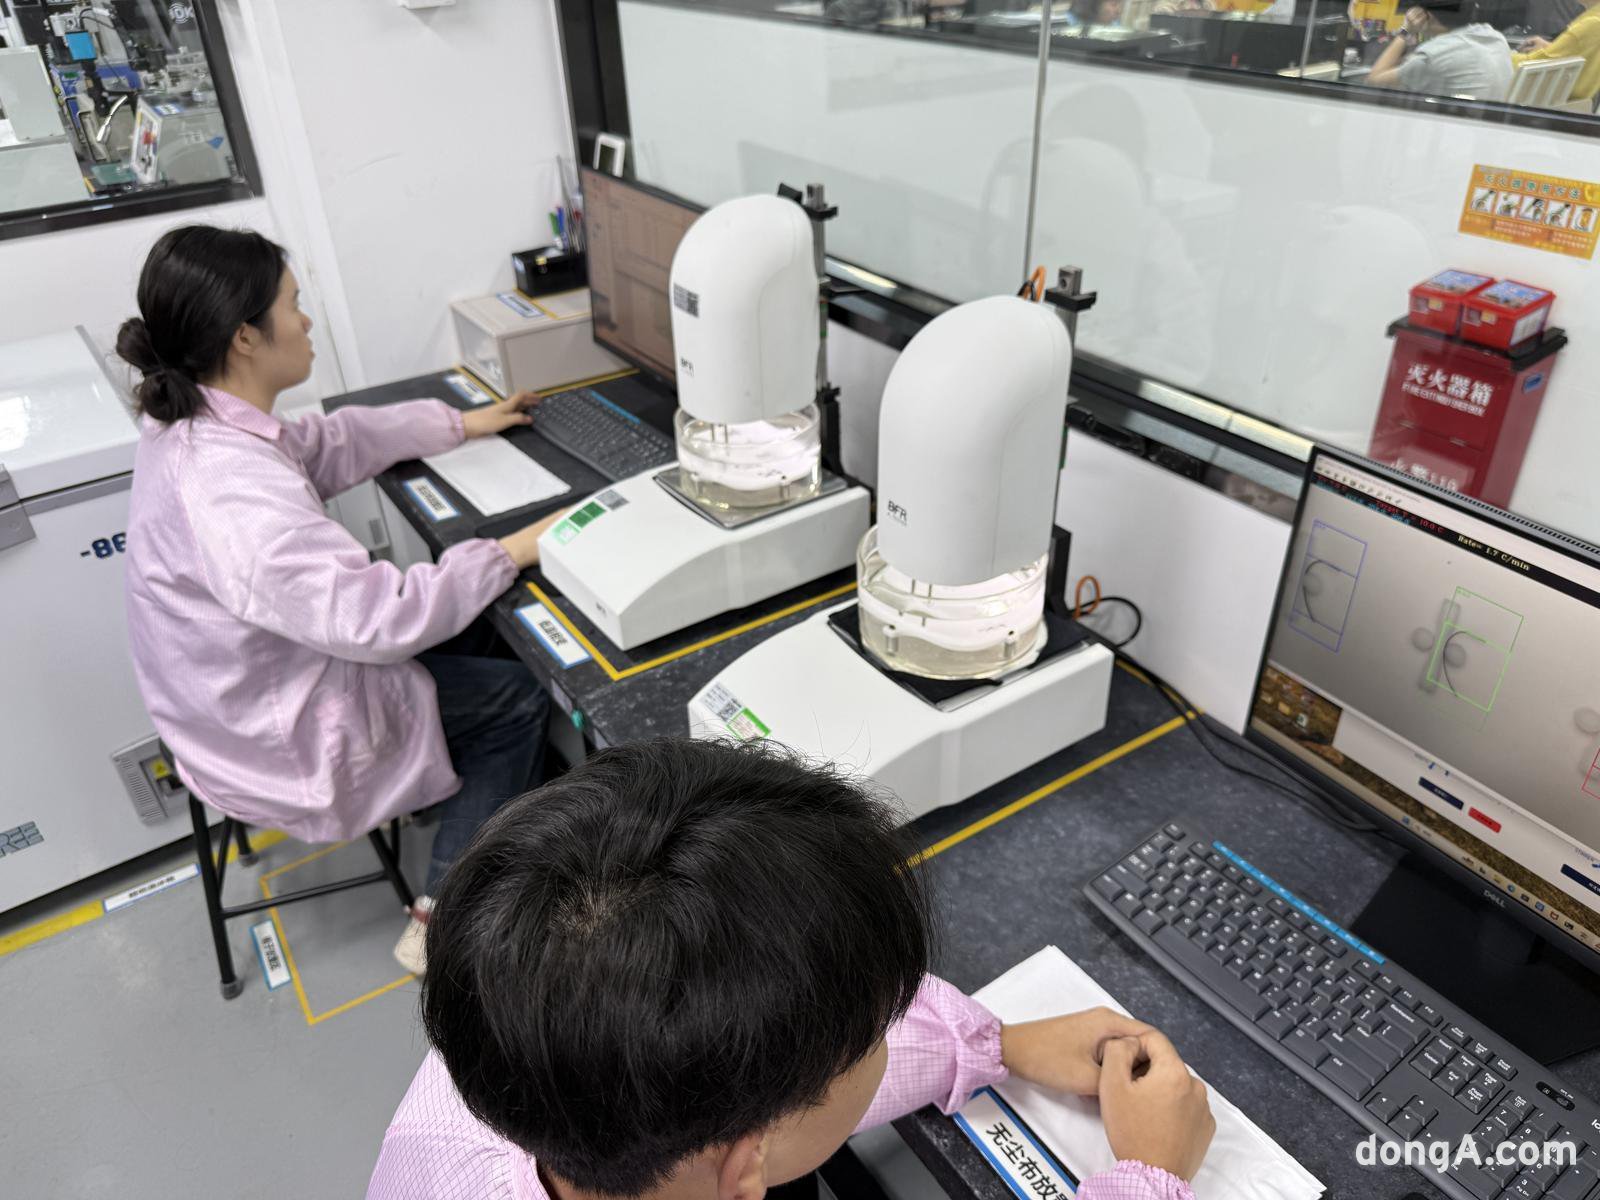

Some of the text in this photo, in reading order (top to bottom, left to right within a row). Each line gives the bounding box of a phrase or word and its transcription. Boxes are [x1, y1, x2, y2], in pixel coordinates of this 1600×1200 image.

[1404, 362, 1494, 407] 灭火器箱
[888, 500, 907, 521] BFR
